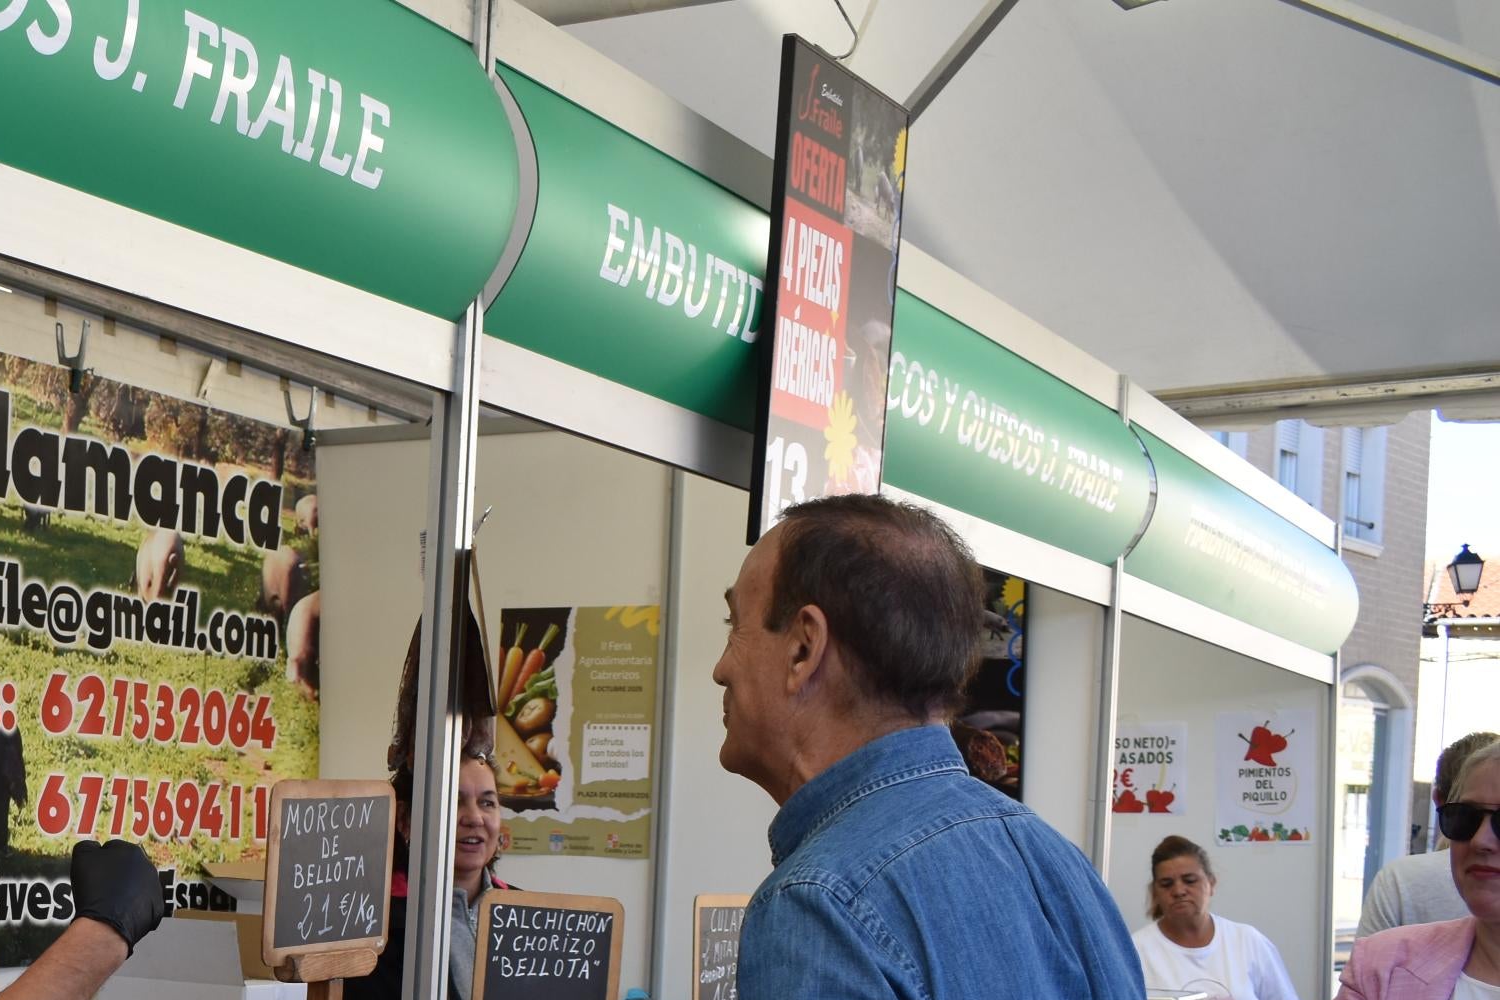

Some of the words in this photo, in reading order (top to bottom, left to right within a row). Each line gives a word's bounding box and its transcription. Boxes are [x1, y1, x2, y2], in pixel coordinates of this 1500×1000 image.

[173, 9, 391, 190] FRAILE
[791, 131, 846, 214] OFERTA
[782, 216, 796, 292] 4
[797, 223, 843, 313] PIEZAS
[775, 303, 837, 409] IBÉRICAS
[940, 377, 959, 434] Y
[1119, 751, 1173, 765] ASADOS
[1238, 767, 1291, 778] PIMIENTOS
[1242, 791, 1287, 802] PIQUILLO
[1255, 780, 1274, 790] DEL
[283, 799, 374, 840] MORCON
[321, 835, 339, 859] DE
[293, 855, 365, 889] BELLOTA
[493, 933, 503, 951] Y
[512, 933, 596, 956] CHORIZO
